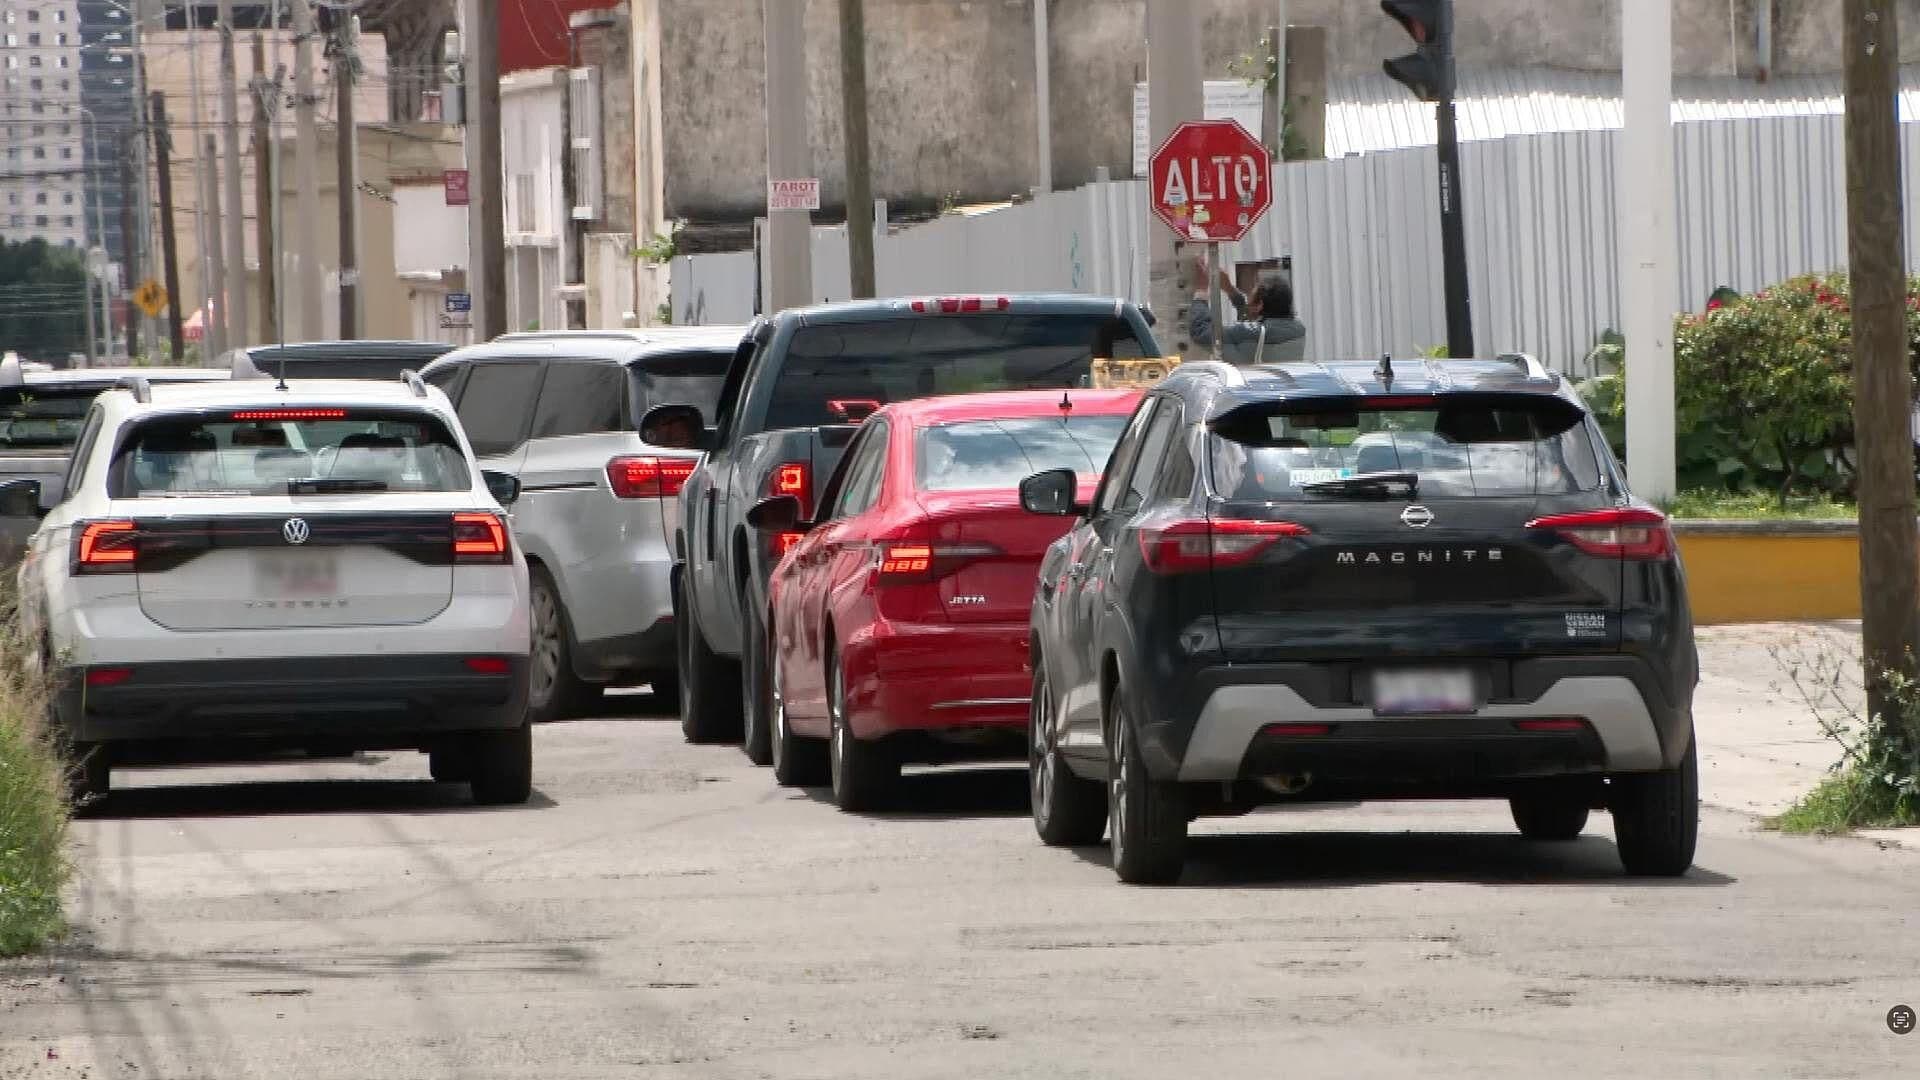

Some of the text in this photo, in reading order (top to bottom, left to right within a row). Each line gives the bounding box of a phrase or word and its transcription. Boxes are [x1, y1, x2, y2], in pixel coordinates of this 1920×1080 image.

[1162, 154, 1258, 204] ALTO
[771, 182, 817, 192] TAROT
[1336, 550, 1502, 562] MAGNITE
[949, 596, 985, 604] JETTA
